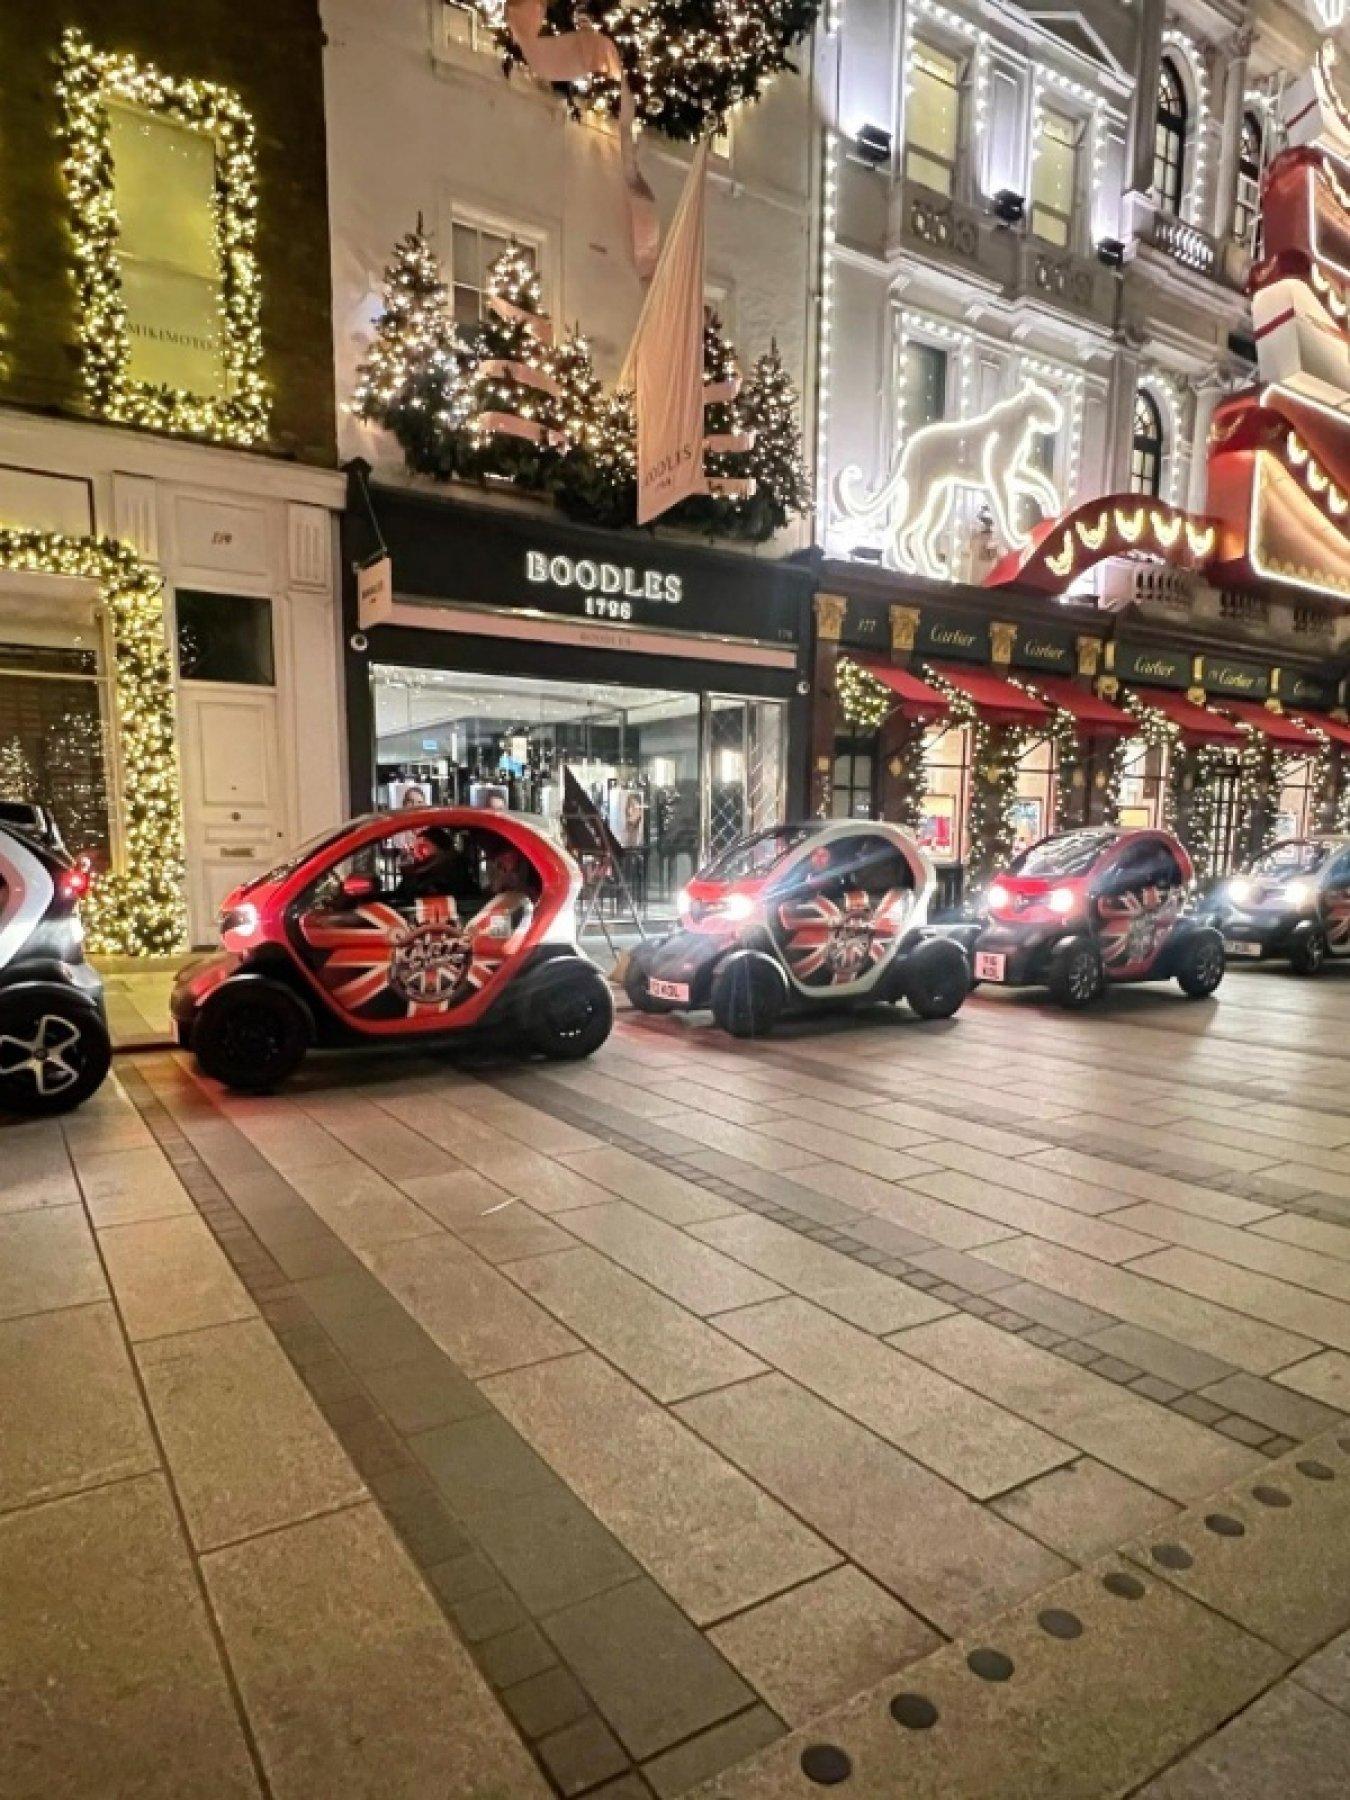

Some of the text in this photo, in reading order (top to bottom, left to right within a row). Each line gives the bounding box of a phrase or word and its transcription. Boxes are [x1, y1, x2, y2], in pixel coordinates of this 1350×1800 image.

[526, 550, 683, 603] BOODLES
[585, 596, 632, 620] 1798
[930, 624, 977, 647] Cartier
